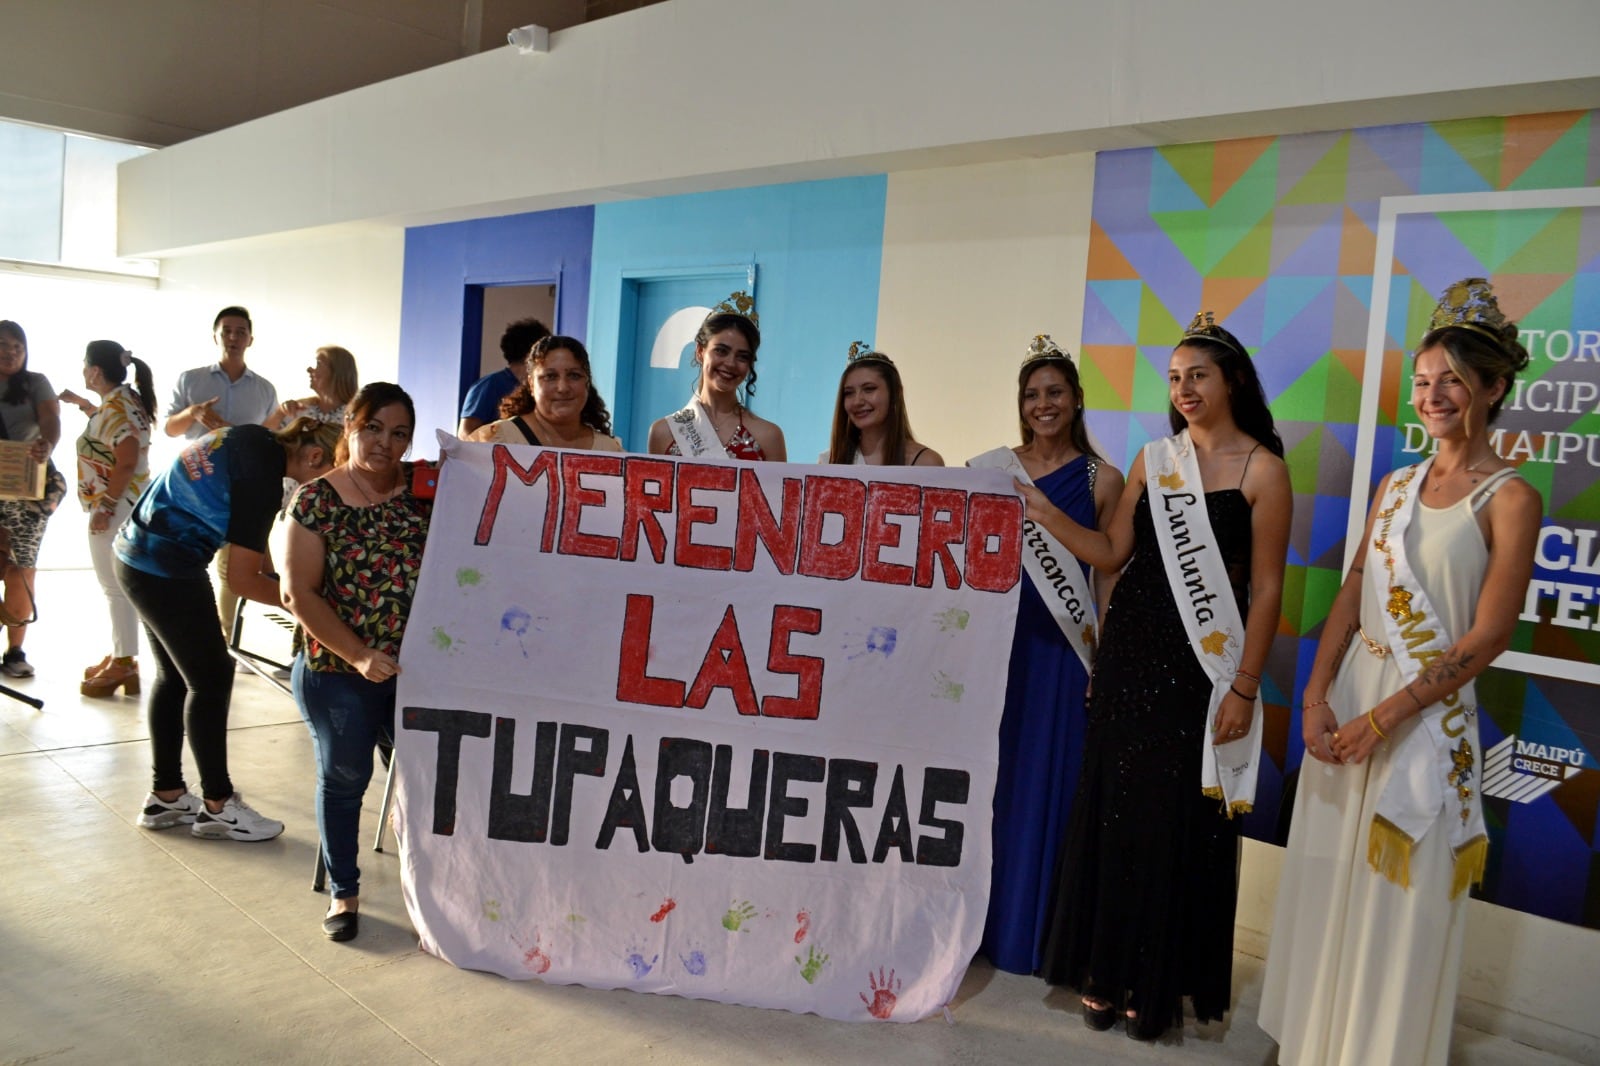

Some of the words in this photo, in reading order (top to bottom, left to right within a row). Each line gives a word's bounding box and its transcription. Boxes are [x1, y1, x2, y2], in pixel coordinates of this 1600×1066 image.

[474, 443, 1025, 594] MERENDERO
[1023, 518, 1086, 625] arrancas
[1162, 492, 1219, 627] Lunlunta
[615, 593, 825, 721] LAS
[402, 706, 971, 868] TUPAQUERAS
[1513, 757, 1560, 777] CRECE
[1515, 739, 1586, 766] MAIPÚ
